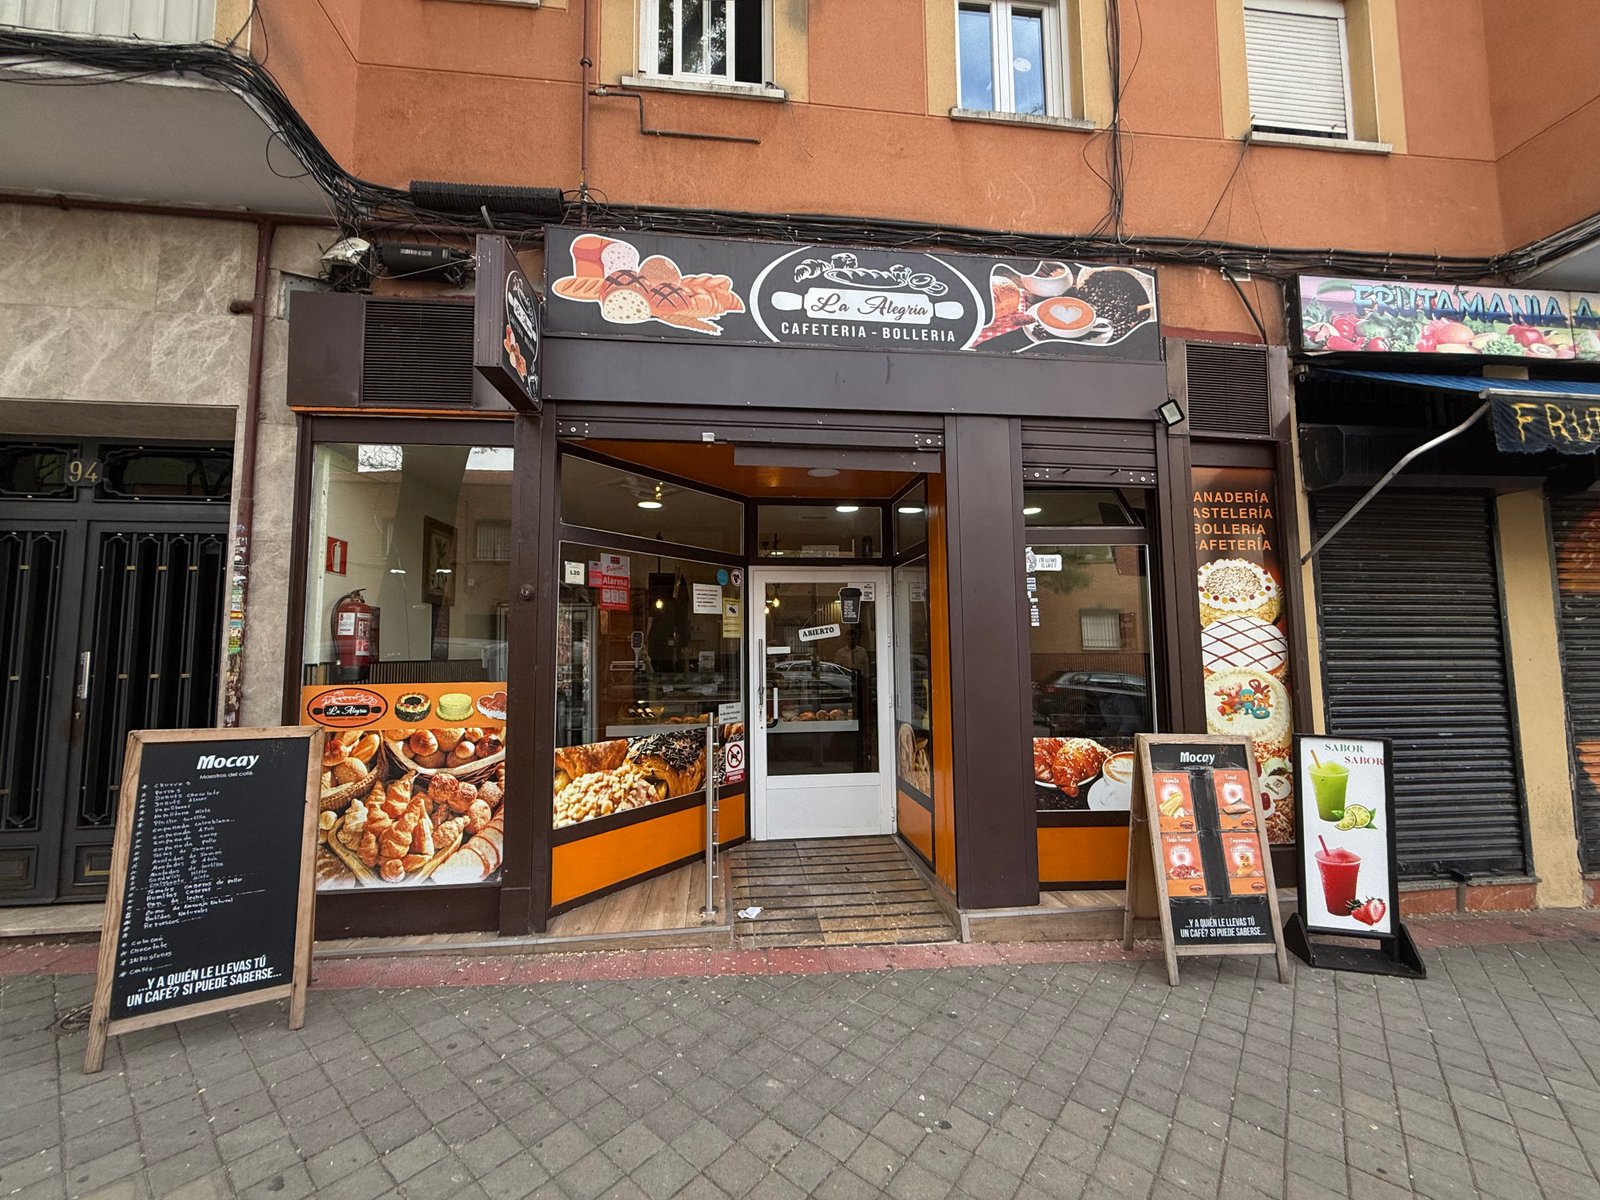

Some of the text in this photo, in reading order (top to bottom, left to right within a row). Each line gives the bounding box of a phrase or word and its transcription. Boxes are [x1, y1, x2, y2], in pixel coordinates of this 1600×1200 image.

[811, 292, 850, 313] La
[1351, 284, 1568, 327] FRUTAMANIA
[781, 322, 866, 338] CAFETERIA
[882, 327, 956, 342] BOLLERIA
[70, 461, 98, 482] 94
[1196, 537, 1271, 550] AFETERÍA
[602, 576, 627, 586] Alarma
[802, 627, 834, 637] ABIERTO
[1324, 744, 1364, 752] SABOR
[196, 755, 260, 770] Mocay
[1180, 752, 1215, 765] Mocay
[1344, 755, 1384, 765] SABOR
[1194, 919, 1199, 927] A
[1200, 916, 1217, 928] QUIÉN
[1218, 918, 1225, 927] LE
[1226, 917, 1247, 926] LLEVAS
[1247, 915, 1255, 926] TÚ
[1180, 929, 1189, 938] UN
[1190, 928, 1208, 937] CAFÉ?
[1210, 928, 1216, 936] SI
[1217, 928, 1235, 936] PUEDE
[156, 978, 164, 988] A
[168, 967, 198, 986] QUIÉN
[200, 967, 214, 979] LE
[215, 959, 252, 976] LLEVAS
[254, 954, 267, 967] TÚ
[127, 993, 143, 1006] UN
[145, 985, 179, 1003] CAFÉ?
[182, 983, 195, 996] SI
[195, 977, 228, 994] PUEDE
